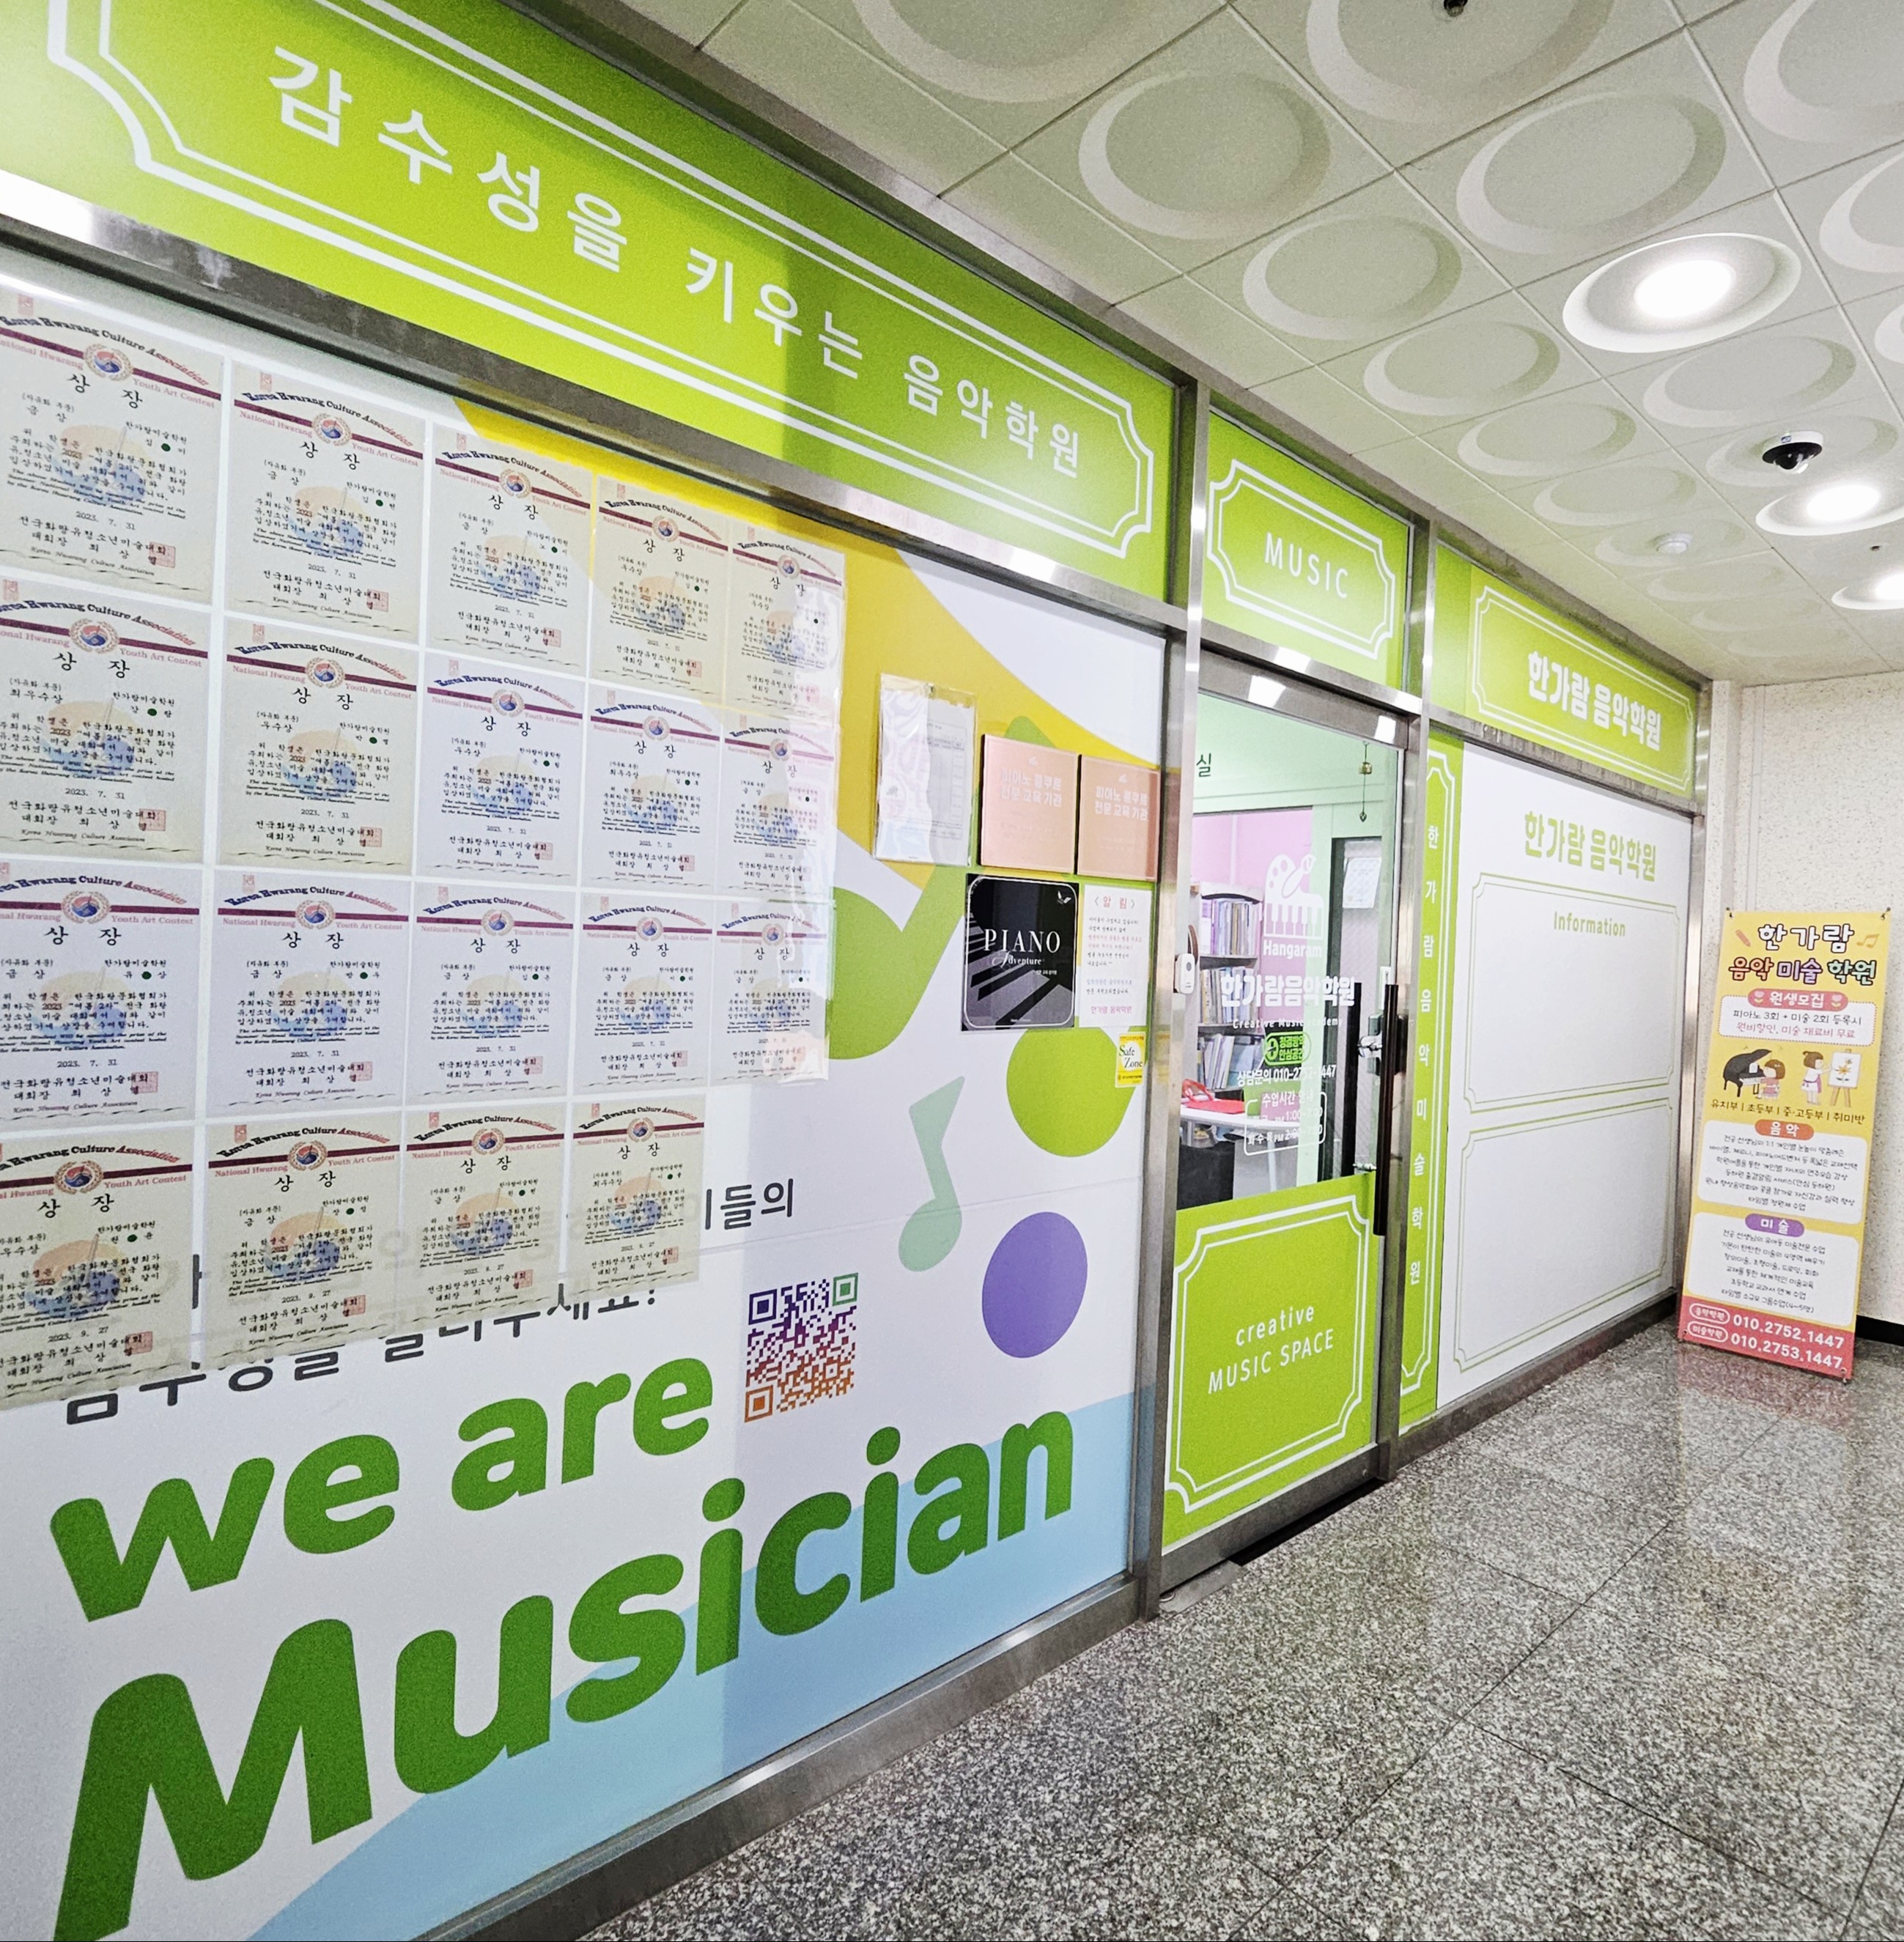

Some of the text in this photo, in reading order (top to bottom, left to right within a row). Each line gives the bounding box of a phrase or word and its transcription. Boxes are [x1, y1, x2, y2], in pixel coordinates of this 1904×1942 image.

[269, 46, 1078, 478] 감수성을 키우는 음악학원
[276, 392, 325, 407] Hwarang
[326, 401, 361, 418] Culture
[362, 415, 413, 446] Association
[239, 410, 275, 427] National
[352, 442, 374, 456] Youth
[377, 448, 388, 459] Art
[390, 452, 418, 467] Contest
[299, 441, 360, 470] 상 장
[1265, 532, 1349, 599] MUSIC
[1528, 650, 1662, 751] 한가람 음악학원
[1196, 753, 1212, 778] 실
[1023, 789, 1042, 805] 교육
[1044, 792, 1062, 808] 기관
[1095, 800, 1149, 822] 전문 교육 기관
[1524, 810, 1658, 883] 한가람 음악학원
[259, 887, 309, 898] Hwarang
[310, 886, 345, 896] Culture
[346, 890, 397, 912] Association
[223, 918, 258, 926] National
[1553, 910, 1626, 938] Information
[281, 931, 344, 950] 상 장
[984, 928, 1060, 953] PIANO
[1263, 939, 1322, 959] Hangaram
[1757, 923, 1856, 953] 한가람
[992, 950, 1042, 968] Adventure
[1728, 956, 1878, 986] 음악 미술 학원
[1221, 973, 1355, 1007] 한가람음악학원
[1769, 991, 1825, 1008] 원생모집
[1733, 1010, 1761, 1019] 피아노
[1763, 1011, 1779, 1020] 3회
[1791, 1014, 1811, 1024] 미술
[1813, 1014, 1829, 1024] 2회
[1832, 1015, 1862, 1026] 등록시
[1782, 1026, 1801, 1036] 미술
[1804, 1027, 1833, 1038] 재료비
[1837, 1028, 1856, 1038] 무료
[1119, 1044, 1135, 1057] Safe
[1124, 1057, 1143, 1068] Zone
[1262, 1090, 1295, 1108] 수업시간
[1711, 1099, 1738, 1111] 유치부
[1746, 1102, 1774, 1115] 초등부
[1833, 1112, 1866, 1126] 취미반
[8, 1145, 181, 1167] Hwarang Culture Association
[618, 1142, 660, 1160] 상 장
[104, 1175, 186, 1189] Youth Art Contest
[37, 1193, 114, 1219] 상 장
[1236, 1305, 1315, 1347] creative
[1733, 1314, 1845, 1349] 010.2752.1447
[1208, 1328, 1334, 1394] MUSIC SPACE
[1730, 1332, 1842, 1370] 010.2753.1447
[50, 1356, 713, 1622] we are
[53, 1408, 1074, 1942] Musician
